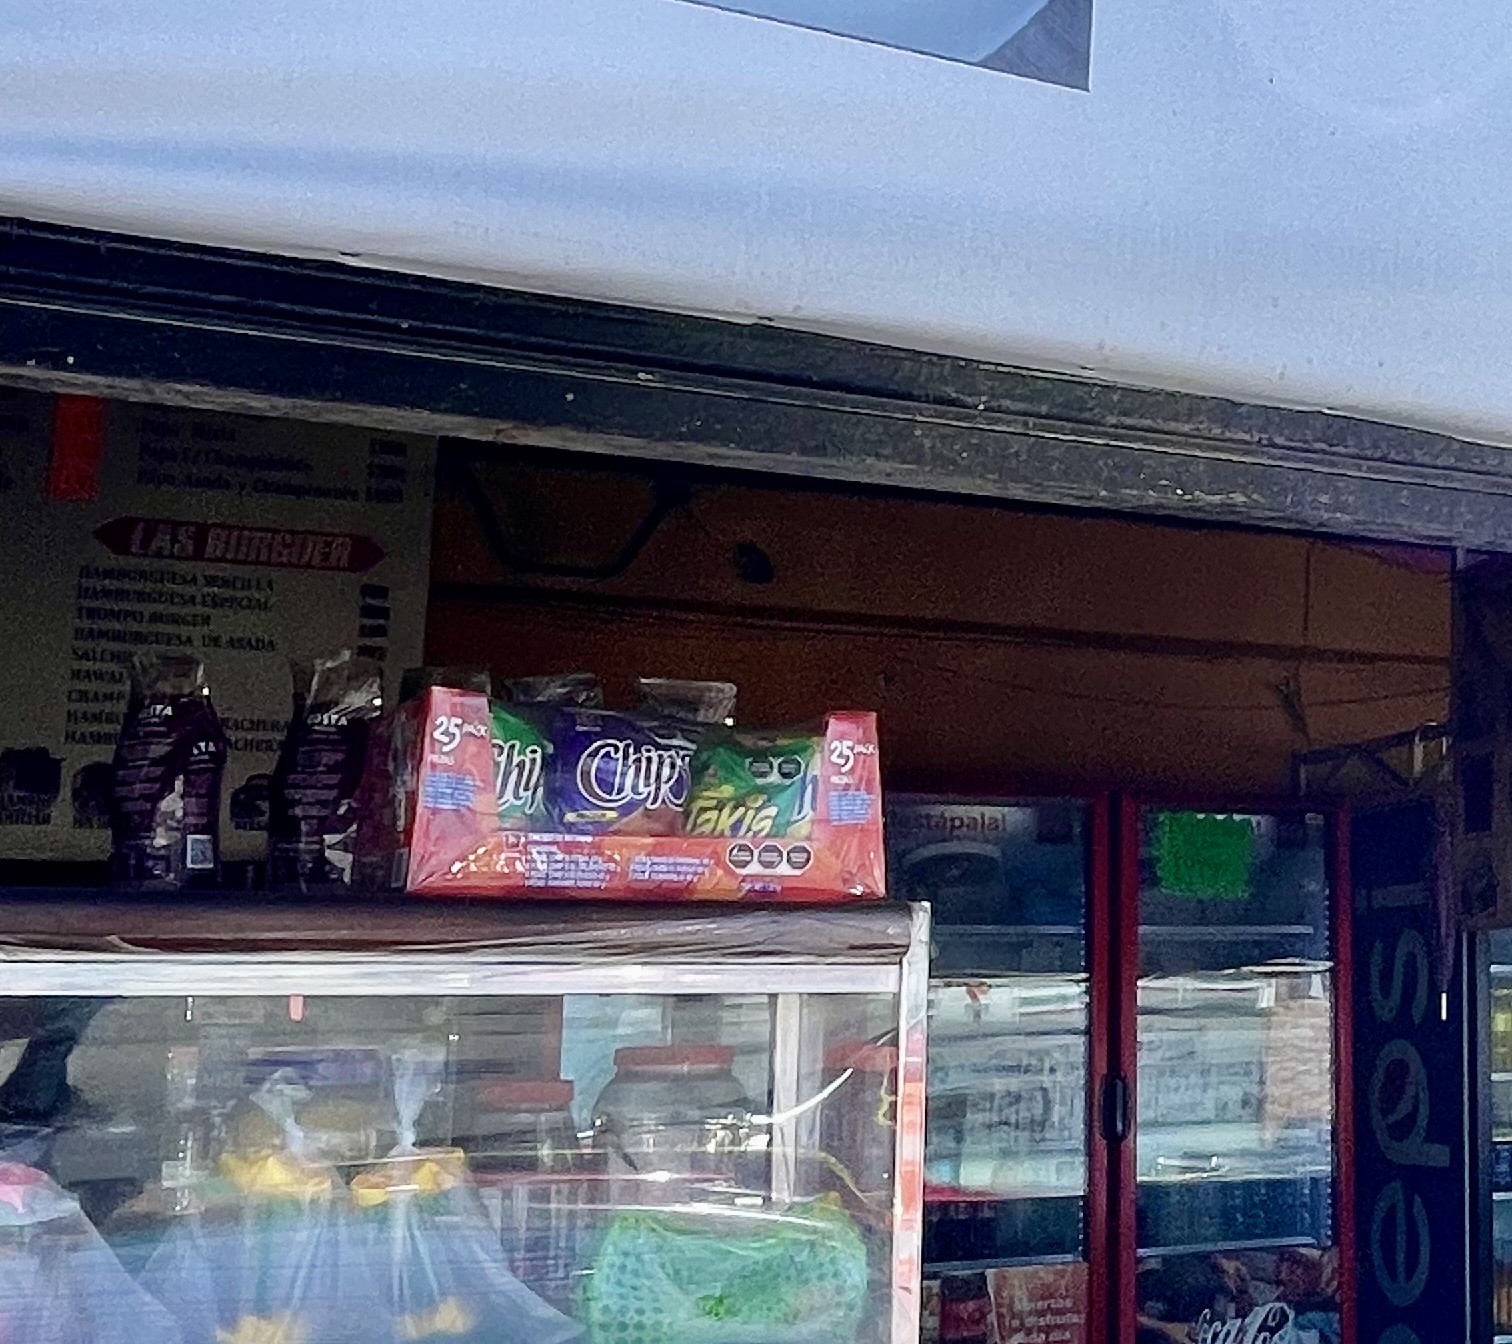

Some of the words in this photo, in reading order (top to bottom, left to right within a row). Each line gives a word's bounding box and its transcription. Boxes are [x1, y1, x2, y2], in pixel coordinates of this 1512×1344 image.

[129, 521, 198, 557] LAS
[432, 715, 464, 753] 25
[829, 741, 855, 773] 25
